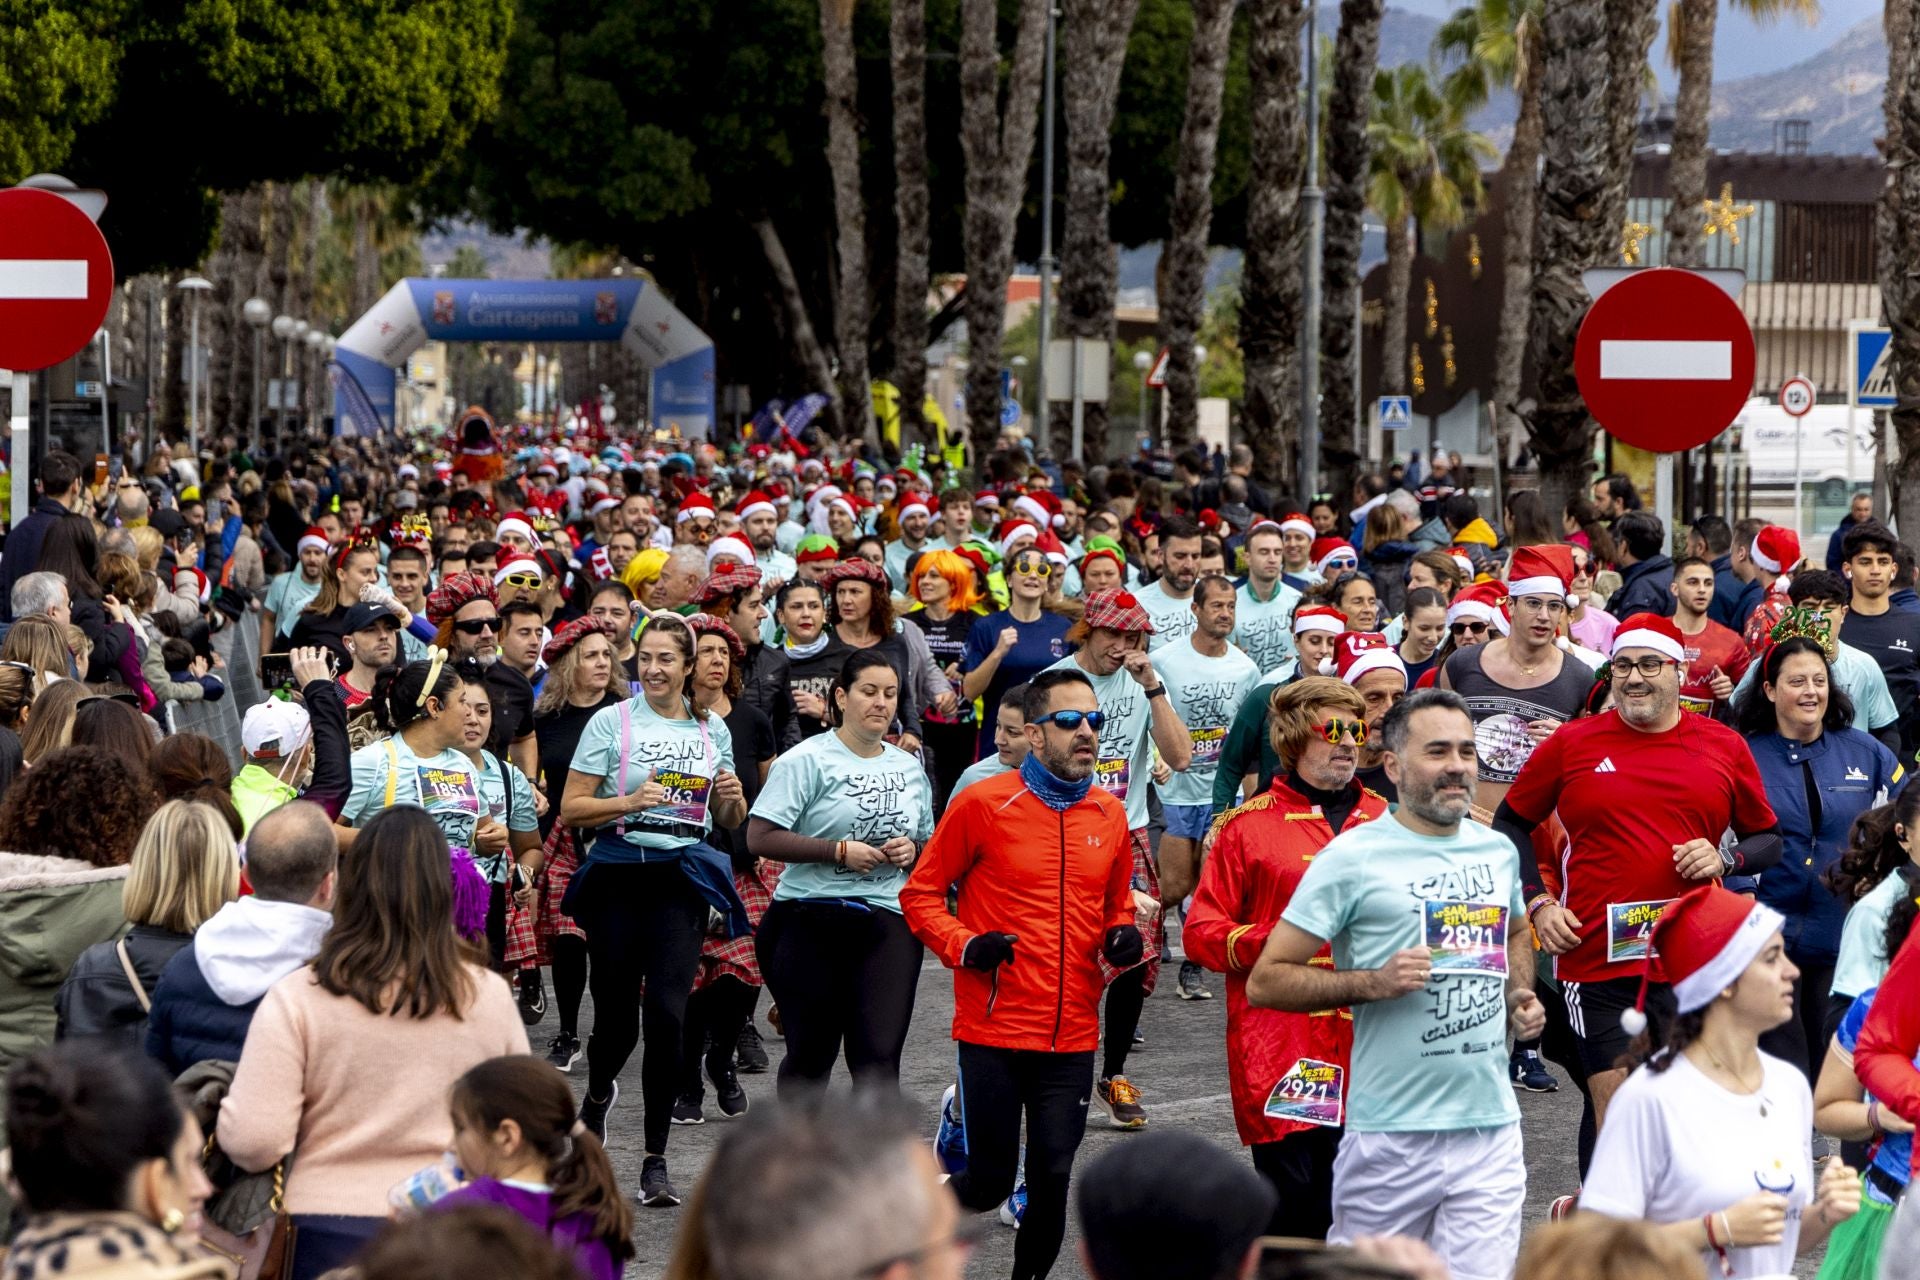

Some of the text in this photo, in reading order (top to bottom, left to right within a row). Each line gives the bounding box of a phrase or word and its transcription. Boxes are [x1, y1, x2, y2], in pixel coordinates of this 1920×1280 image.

[469, 290, 579, 308] Ayuntamiento
[468, 308, 579, 327] Cartagena
[1241, 614, 1288, 638] SAN
[1181, 681, 1236, 703] SAN
[1100, 696, 1134, 722] AN
[1188, 700, 1226, 721] SIL
[639, 739, 704, 763] SAN
[1191, 739, 1222, 753] 2887
[661, 777, 706, 788] SILVESTRE
[663, 772, 682, 780] SAN
[844, 772, 906, 797] SAN
[430, 782, 468, 800] 1851
[663, 786, 693, 805] 863
[856, 793, 903, 820] SIL
[847, 816, 910, 842] VES
[1407, 864, 1494, 905] SAN
[1443, 903, 1467, 915] SAN
[1443, 907, 1501, 925] SILVESTRE
[1627, 907, 1664, 926] SILVES
[1628, 905, 1650, 917] SAN
[1440, 925, 1493, 952] 2871
[1425, 976, 1501, 1020] TRE
[1421, 998, 1502, 1043] CARTAGEN
[1279, 1077, 1328, 1104] 2921
